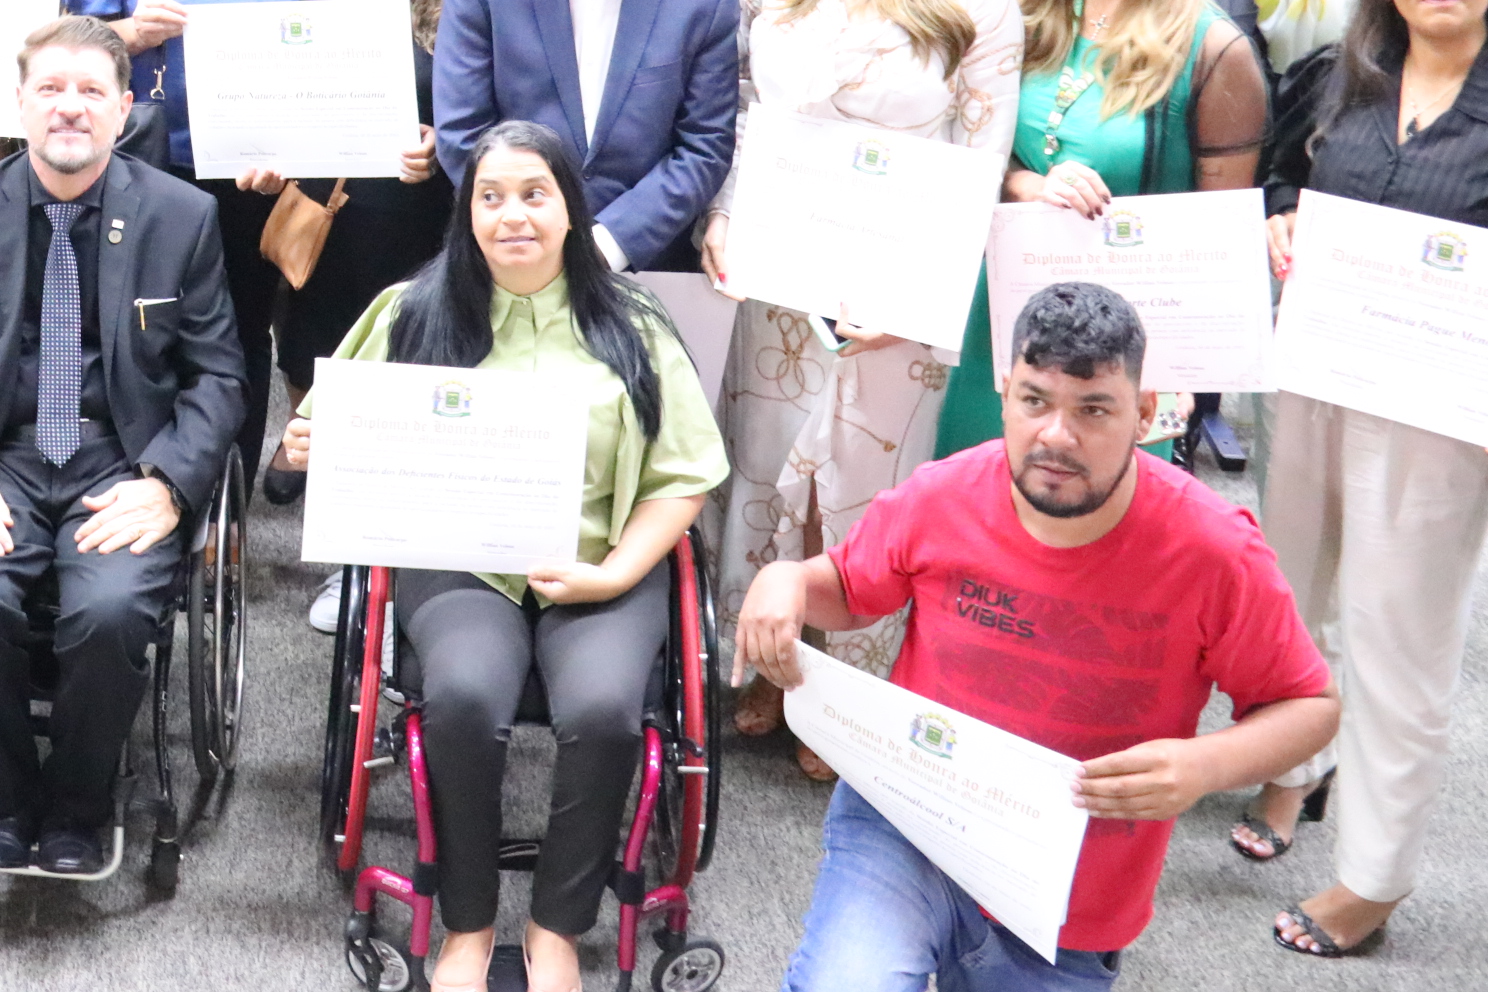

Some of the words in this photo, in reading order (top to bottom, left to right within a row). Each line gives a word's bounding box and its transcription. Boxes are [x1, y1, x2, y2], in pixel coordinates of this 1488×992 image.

[216, 91, 245, 103] Grupo
[249, 91, 288, 101] Natureza
[296, 91, 304, 100] O
[306, 90, 348, 100] Boticário
[349, 90, 387, 100] Goiânia
[1021, 252, 1083, 267] Diploma
[1087, 251, 1102, 265] de
[1157, 251, 1173, 263] ao
[1330, 247, 1394, 274] Diploma
[1149, 296, 1181, 309] Clube
[1361, 304, 1416, 328] Farmácia
[1419, 319, 1456, 336] Pague
[350, 415, 408, 432] Diploma
[332, 465, 379, 476] Associação
[380, 468, 396, 476] dos
[398, 468, 445, 480] Deficientes
[480, 474, 491, 483] do
[493, 475, 522, 485] Estado
[524, 476, 535, 485] de
[961, 579, 1019, 614] DIUK
[958, 602, 1035, 638] VIBES
[822, 702, 883, 746] Diploma
[887, 736, 903, 755] de
[961, 777, 980, 792] ao
[982, 786, 1042, 820] Mérito
[873, 774, 945, 820] Centroálcool
[944, 816, 968, 834] S/A
